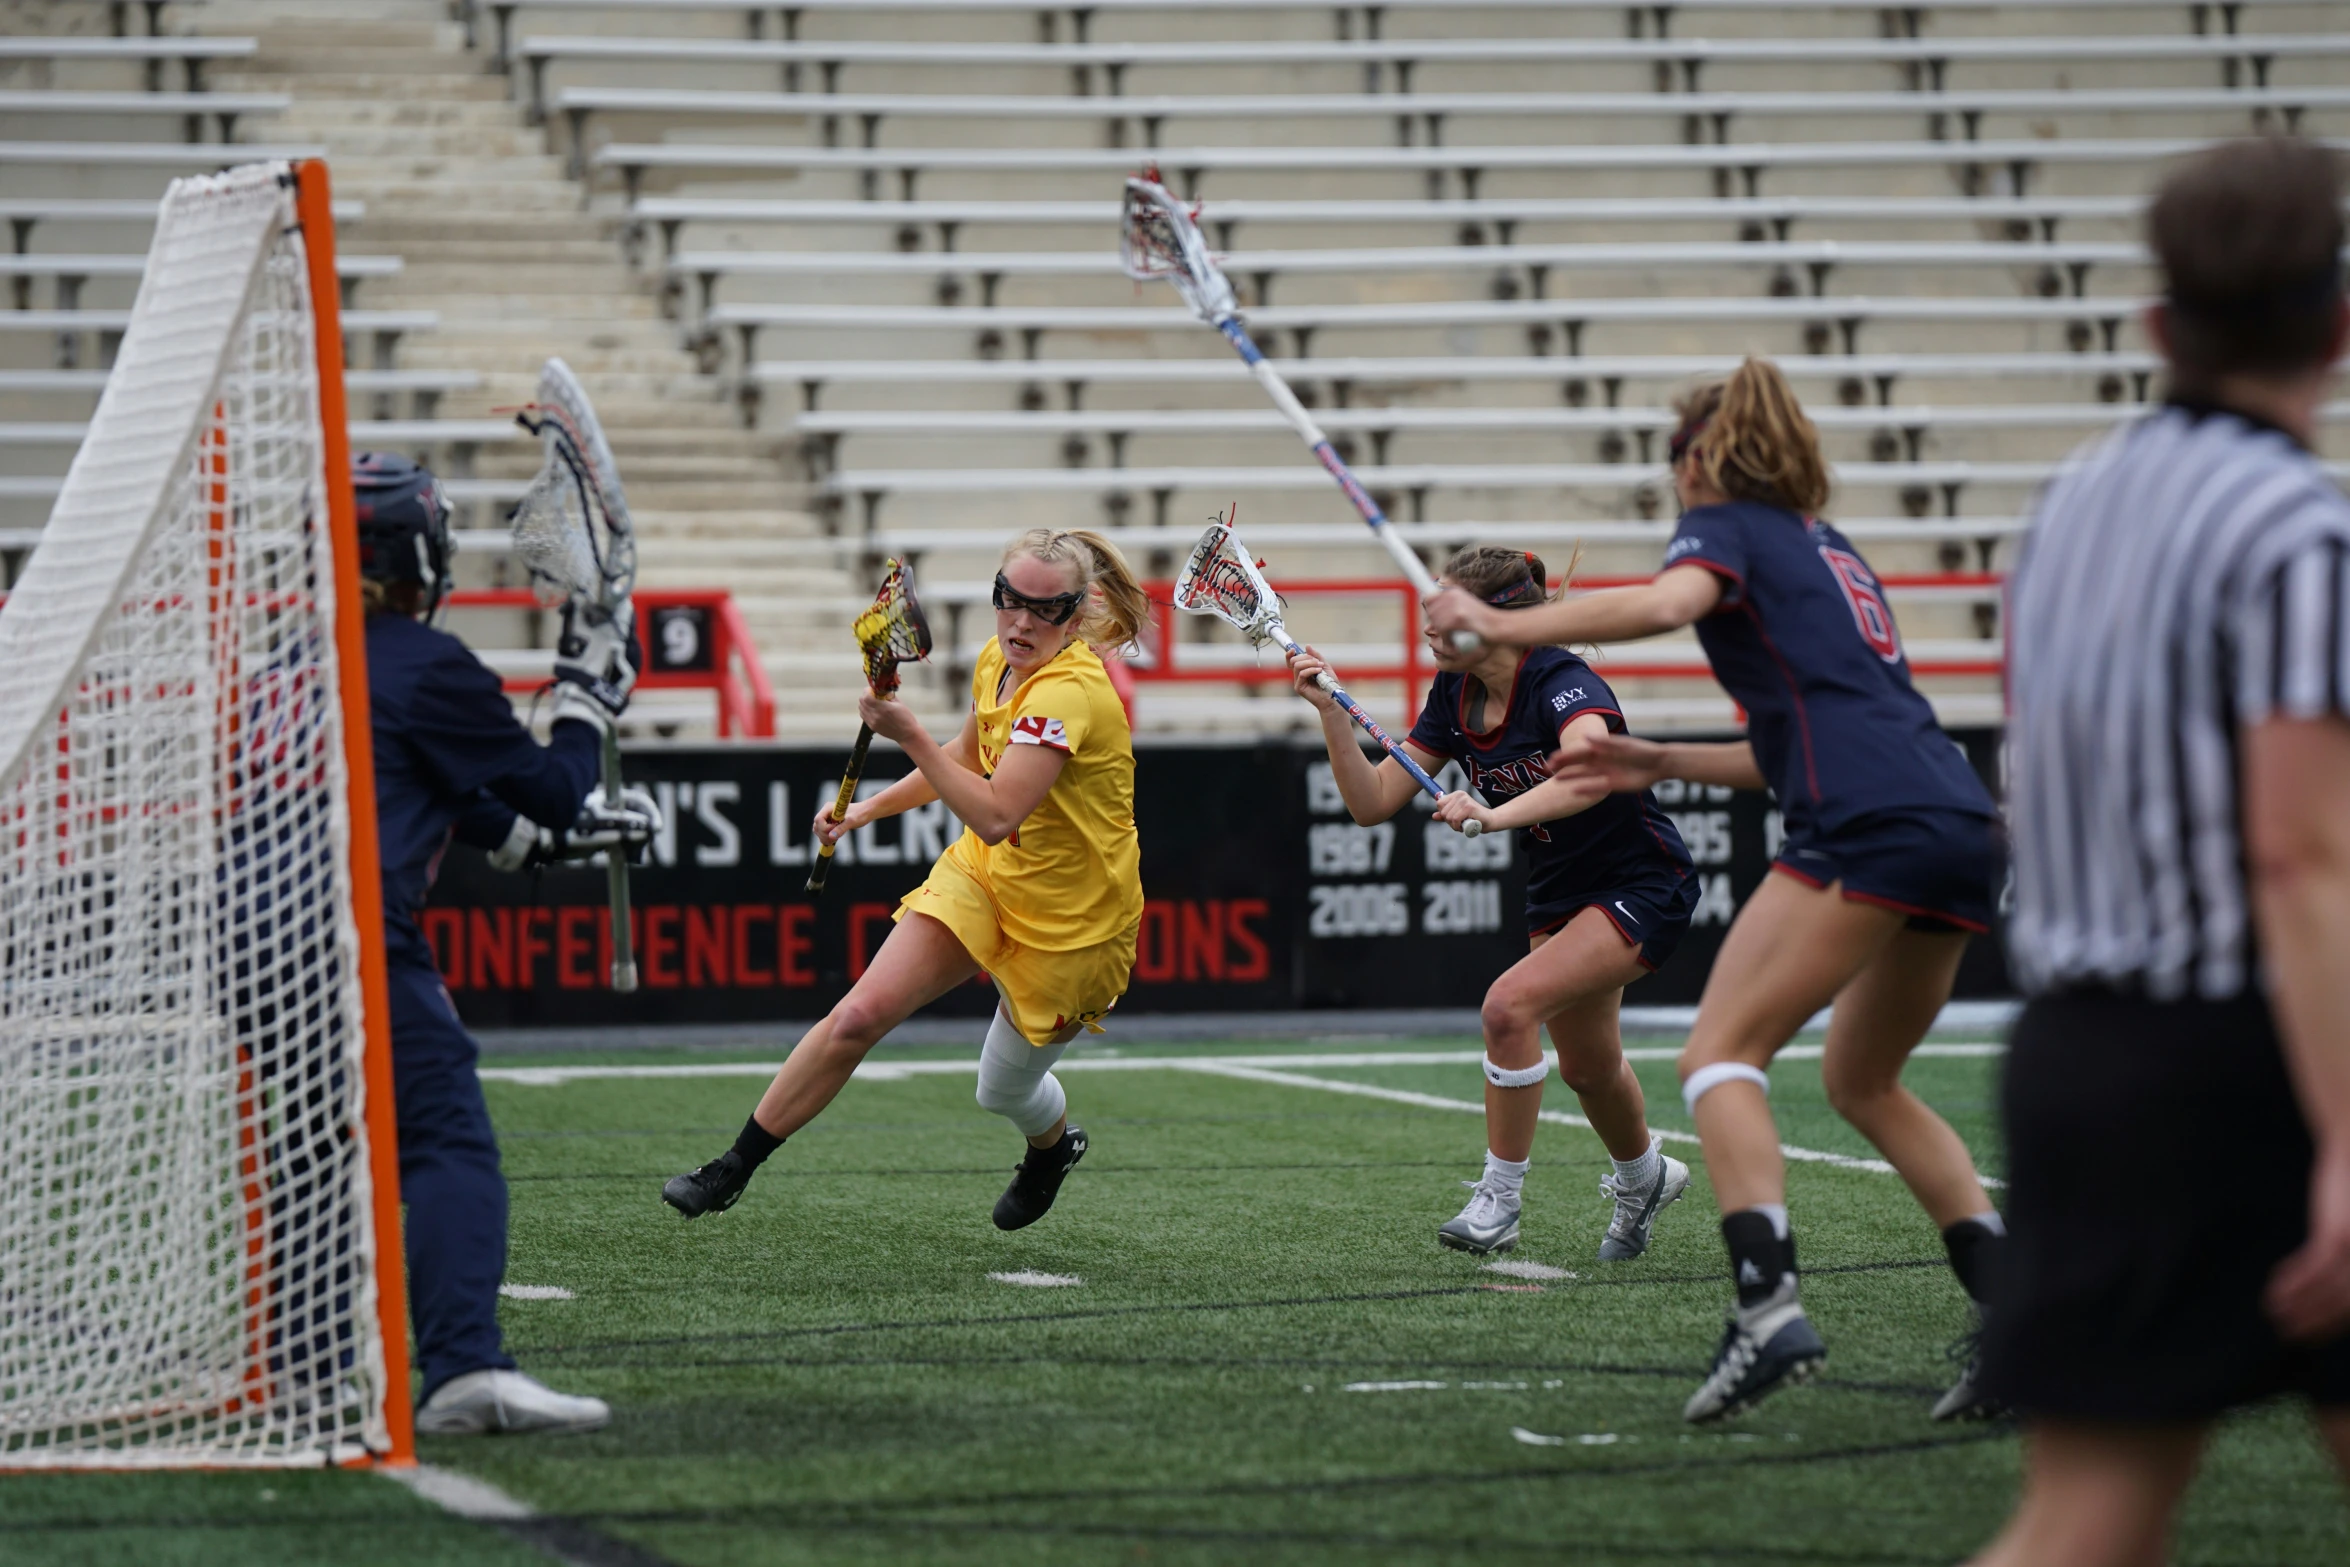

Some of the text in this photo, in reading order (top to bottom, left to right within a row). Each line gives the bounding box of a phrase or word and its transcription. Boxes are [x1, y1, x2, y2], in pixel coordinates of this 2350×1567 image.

[1818, 544, 1900, 665] 6
[661, 616, 700, 666] 9
[1560, 686, 1584, 704] IVY
[1349, 704, 1399, 753] PENN
[1308, 823, 1396, 875] 1987
[1422, 879, 1502, 933] 2011
